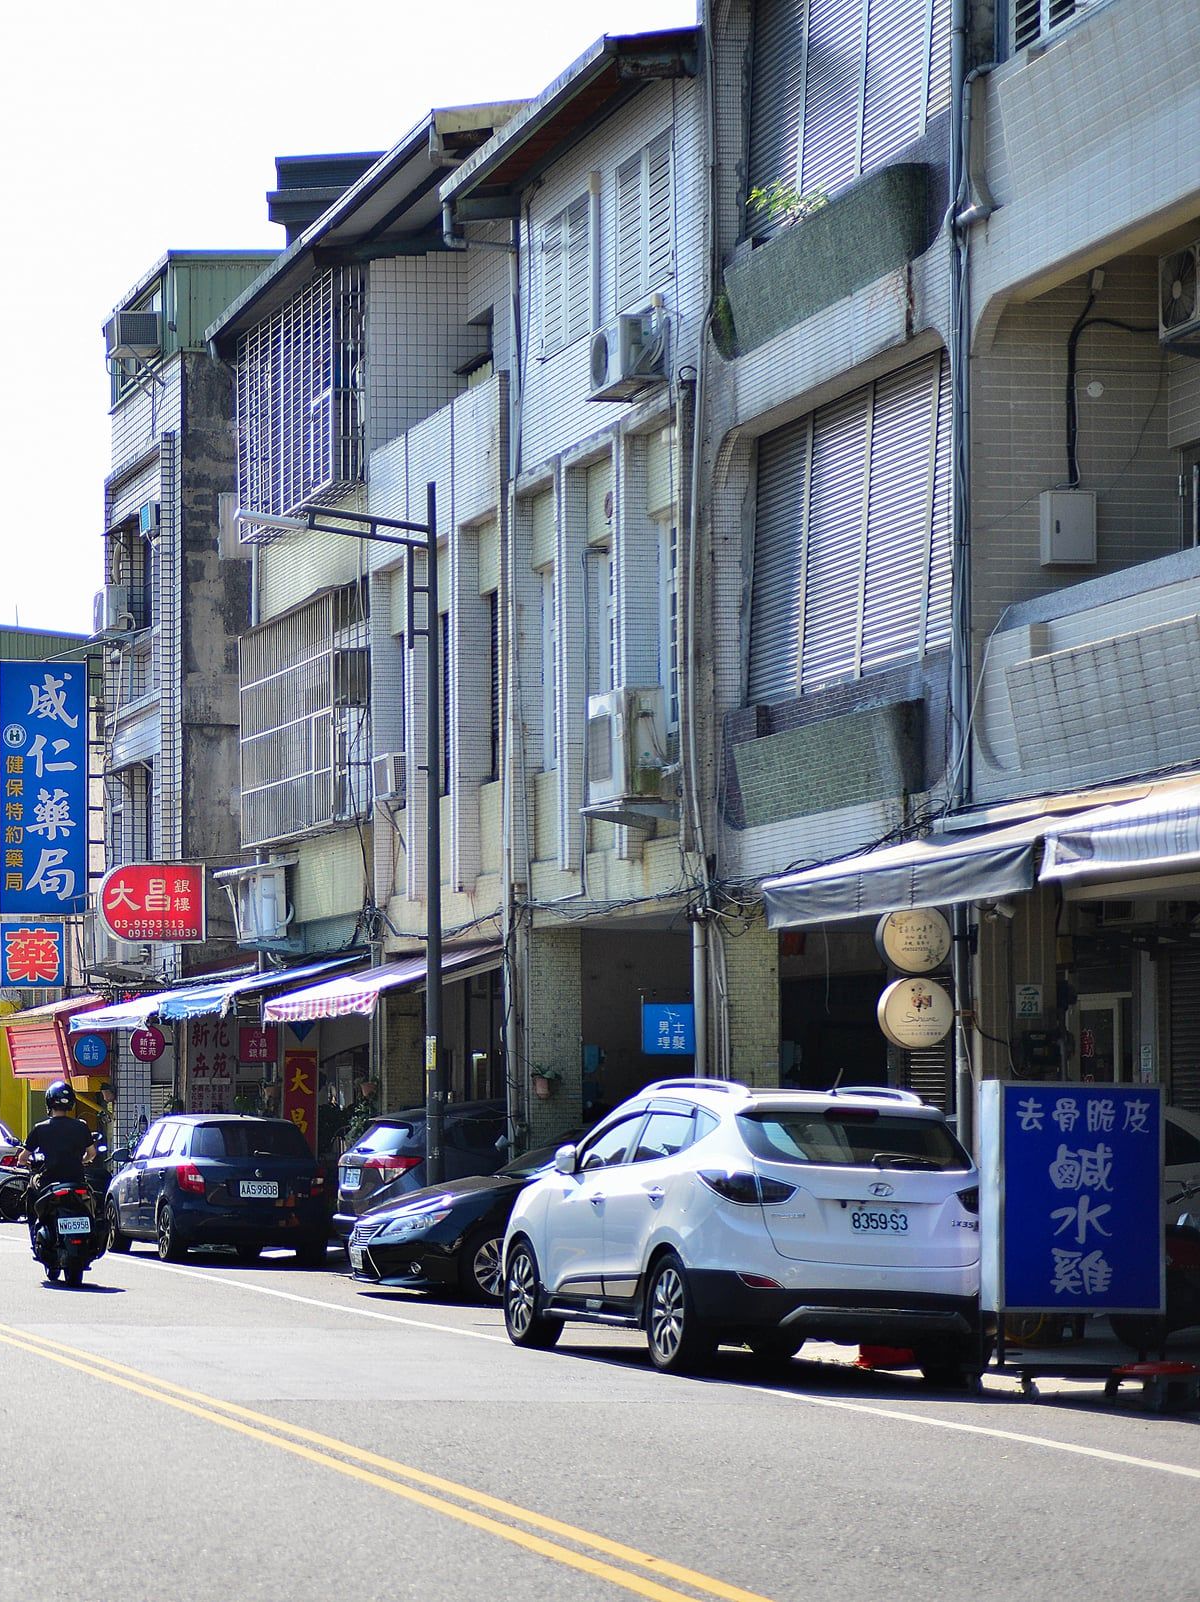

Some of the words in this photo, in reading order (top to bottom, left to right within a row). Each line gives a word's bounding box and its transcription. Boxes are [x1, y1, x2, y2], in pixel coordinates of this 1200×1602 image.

[26, 671, 79, 901] 威仁藥局
[5, 755, 24, 892] 健保特約藥局
[106, 878, 171, 912] 大昌
[173, 879, 191, 912] 銀樓
[7, 928, 60, 982] 藥
[657, 1035, 686, 1050] 理髮
[658, 1020, 686, 1035] 男士
[1015, 1096, 1152, 1134] 去骨脆皮
[851, 1212, 909, 1231] 8359-S3
[1049, 1143, 1115, 1296] 鹹水雞
